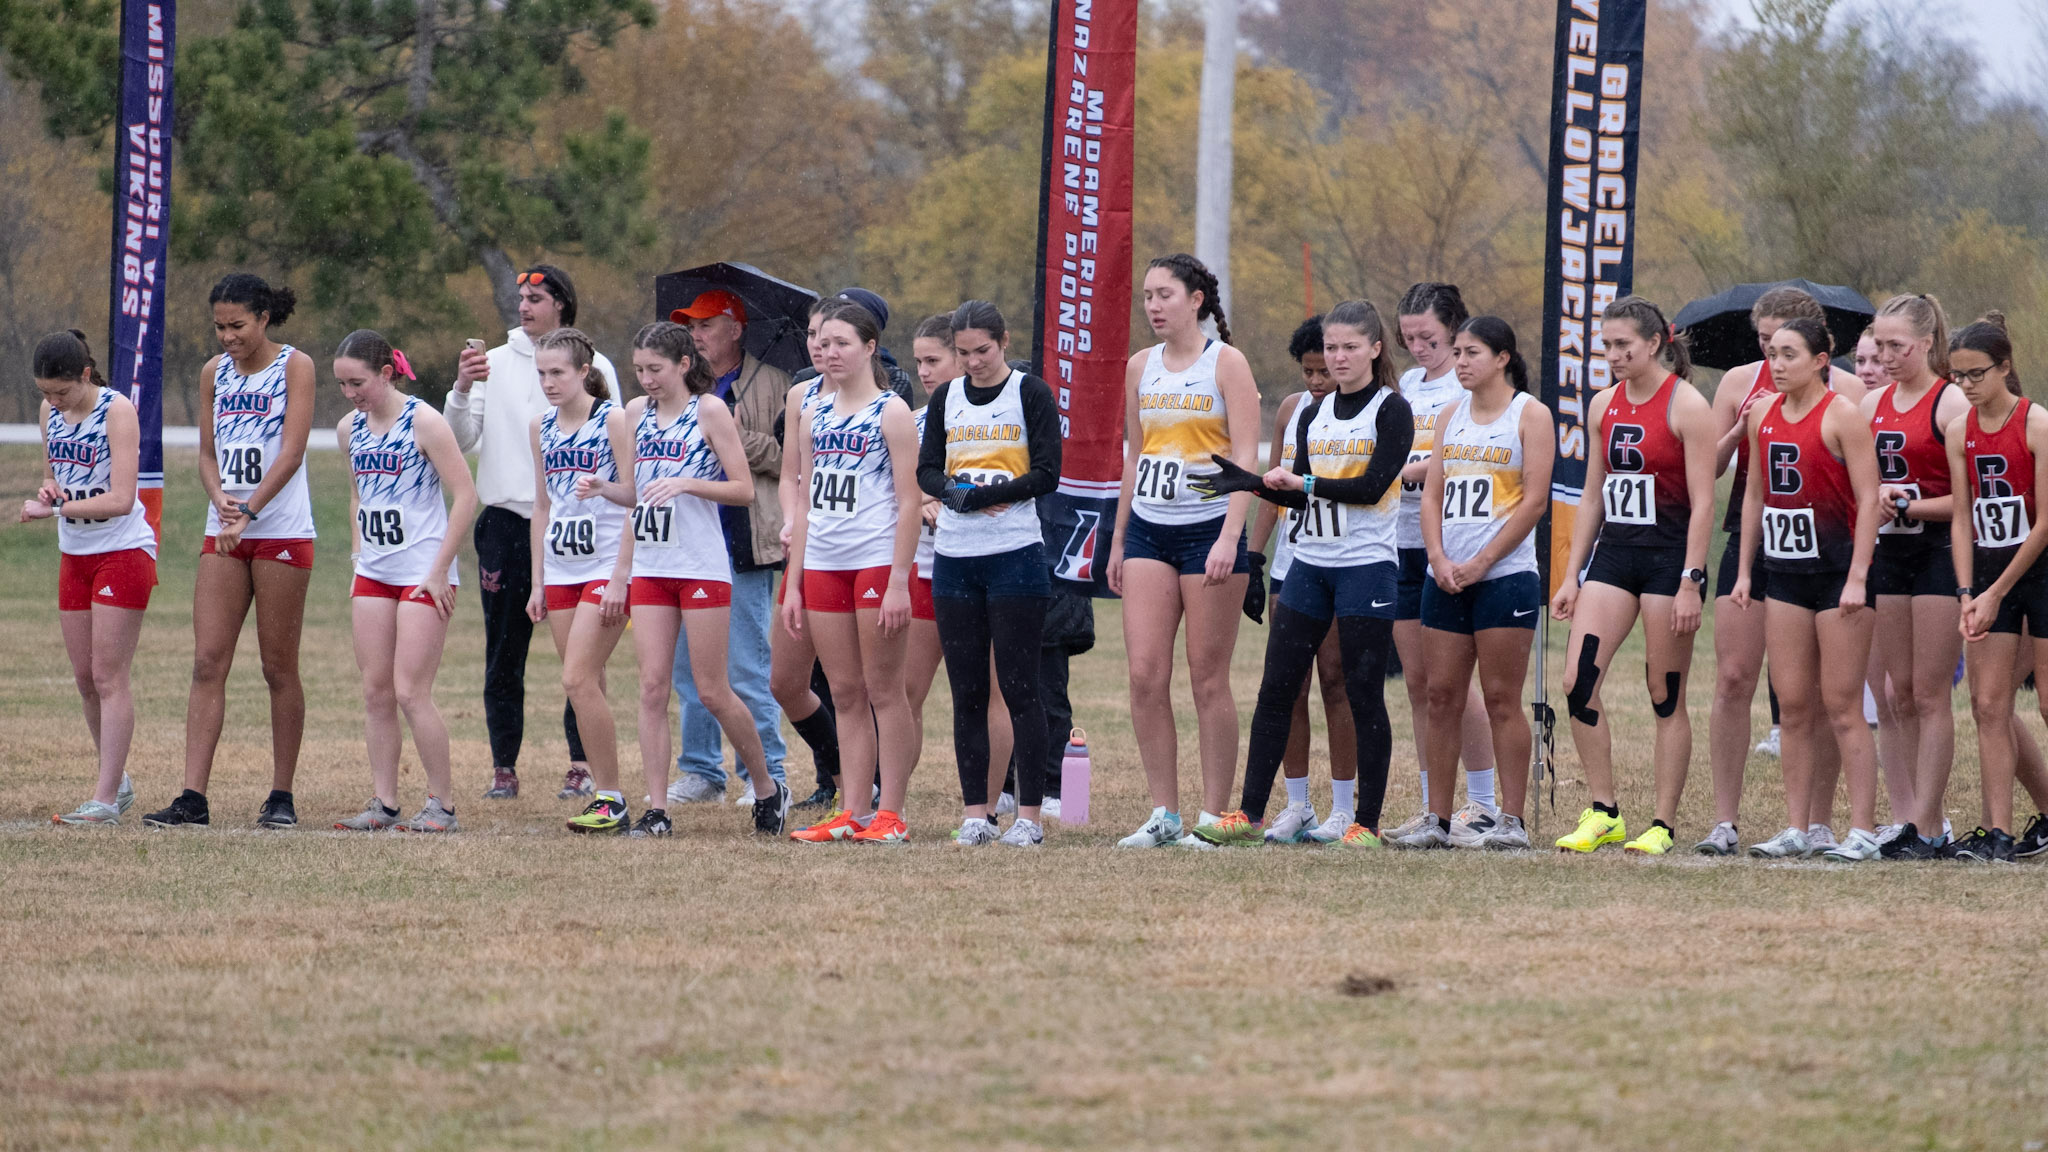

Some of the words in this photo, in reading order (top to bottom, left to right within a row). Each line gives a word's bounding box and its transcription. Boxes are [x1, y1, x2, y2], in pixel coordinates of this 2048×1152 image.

[145, 4, 164, 239] MISSOURI
[1063, 0, 1092, 216] NAZARENE
[122, 122, 146, 317] VIKINGS
[1078, 89, 1104, 353] MIDAMERICA
[1588, 63, 1629, 391] GRACELAND
[129, 258, 157, 413] VALLE
[1057, 231, 1078, 439] PIONEERS
[218, 393, 271, 414] MNU
[640, 440, 684, 459] MNU
[814, 432, 865, 453] MNU
[946, 423, 1022, 443] RACELAND
[1308, 439, 1375, 456] RACELAND
[47, 441, 94, 465] MNU
[221, 447, 262, 485] 248
[354, 452, 400, 472] MNU
[545, 449, 596, 471] MNU
[1442, 444, 1513, 465] GRACELAND
[813, 471, 857, 512] 244
[1137, 458, 1180, 501] 213
[1444, 478, 1490, 519] 212
[1608, 478, 1648, 518] 121
[358, 508, 404, 546] 243
[631, 505, 673, 542] 247
[1304, 499, 1341, 537] 211
[1765, 513, 1814, 553] 129
[1975, 499, 2021, 542] 137
[551, 519, 595, 556] 249
